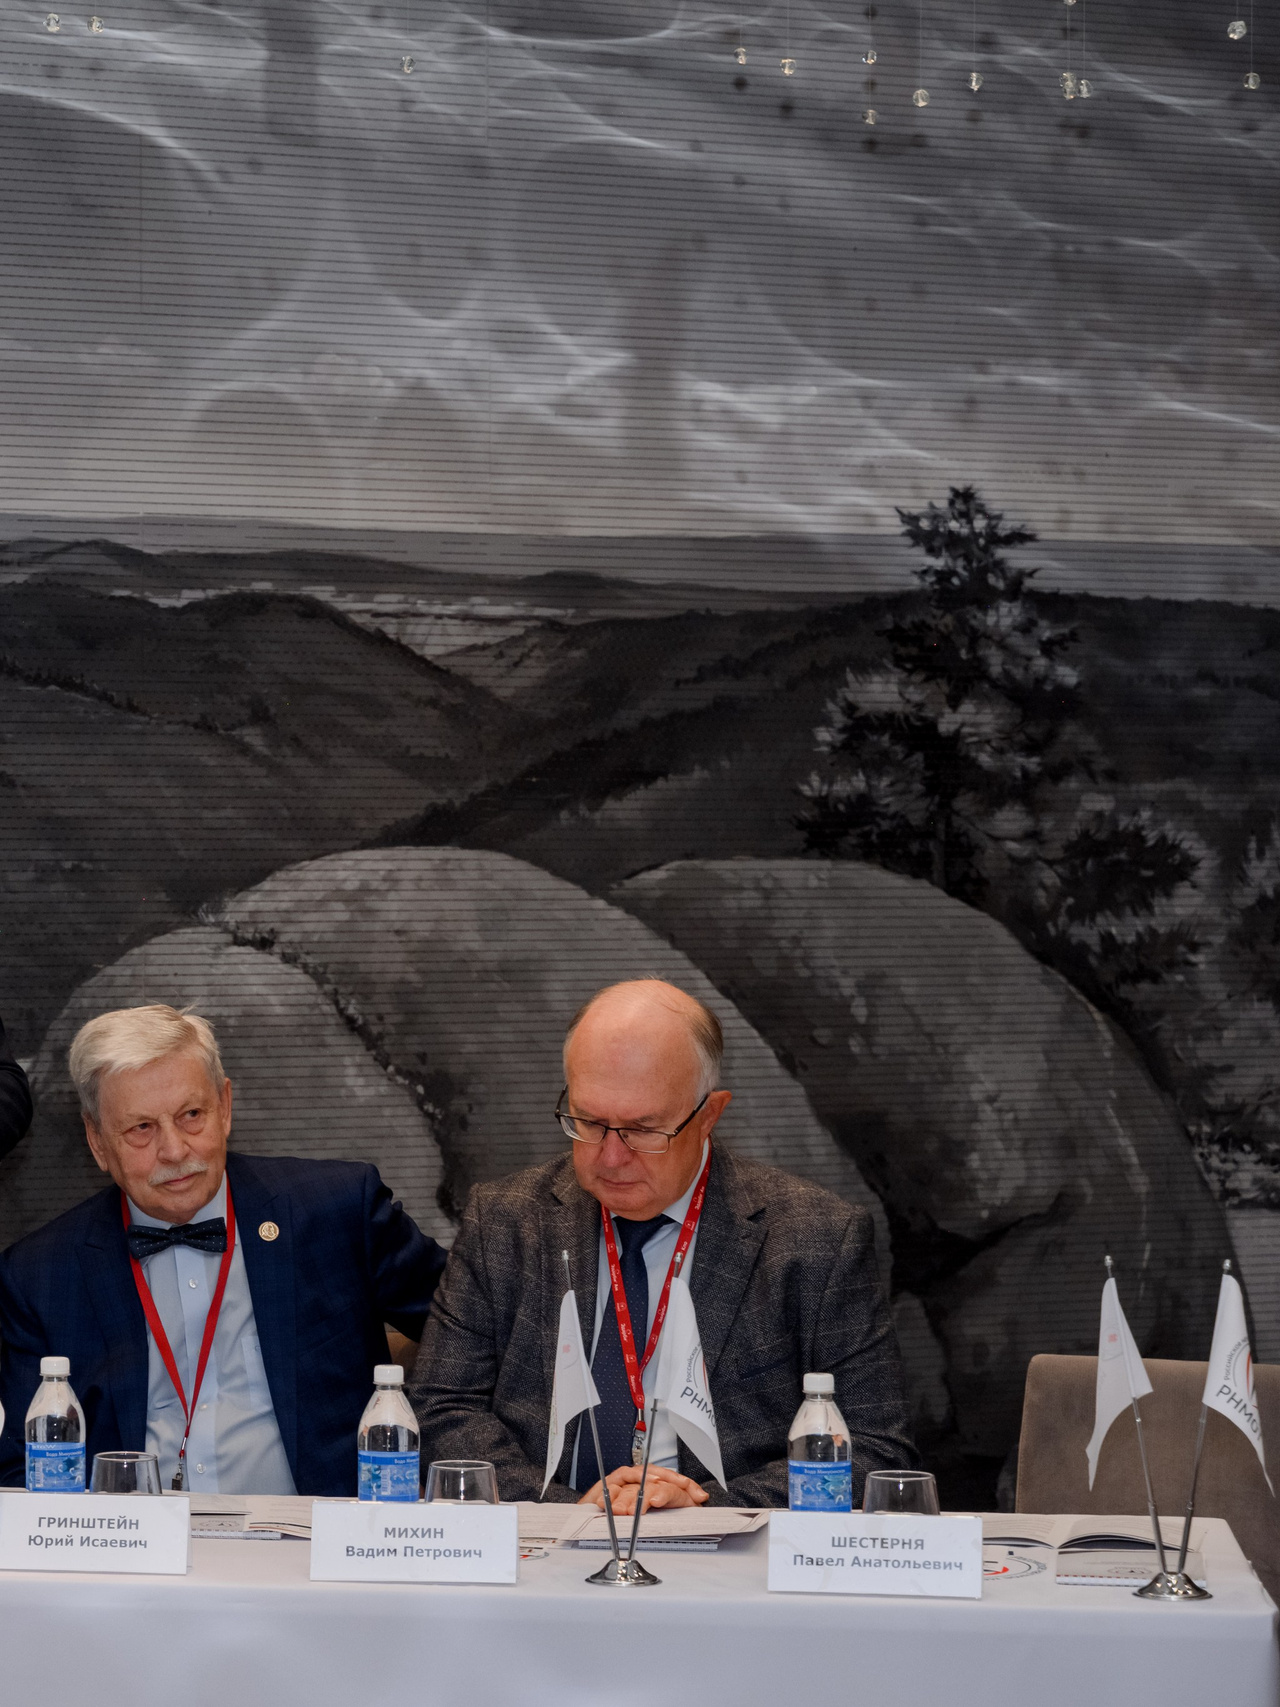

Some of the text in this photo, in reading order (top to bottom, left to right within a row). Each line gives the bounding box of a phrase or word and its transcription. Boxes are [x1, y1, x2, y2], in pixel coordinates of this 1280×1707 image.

[1216, 1384, 1262, 1441] РНМО
[38, 1516, 140, 1530] ГРИНШТЕЙН
[384, 1527, 444, 1539] МИХИН
[28, 1534, 148, 1549] Юрий Исаевич
[831, 1536, 925, 1550] ШЕСТЕРНЯ
[345, 1545, 482, 1560] Вадим Петрович
[793, 1554, 963, 1571] Павел Анатольевич
